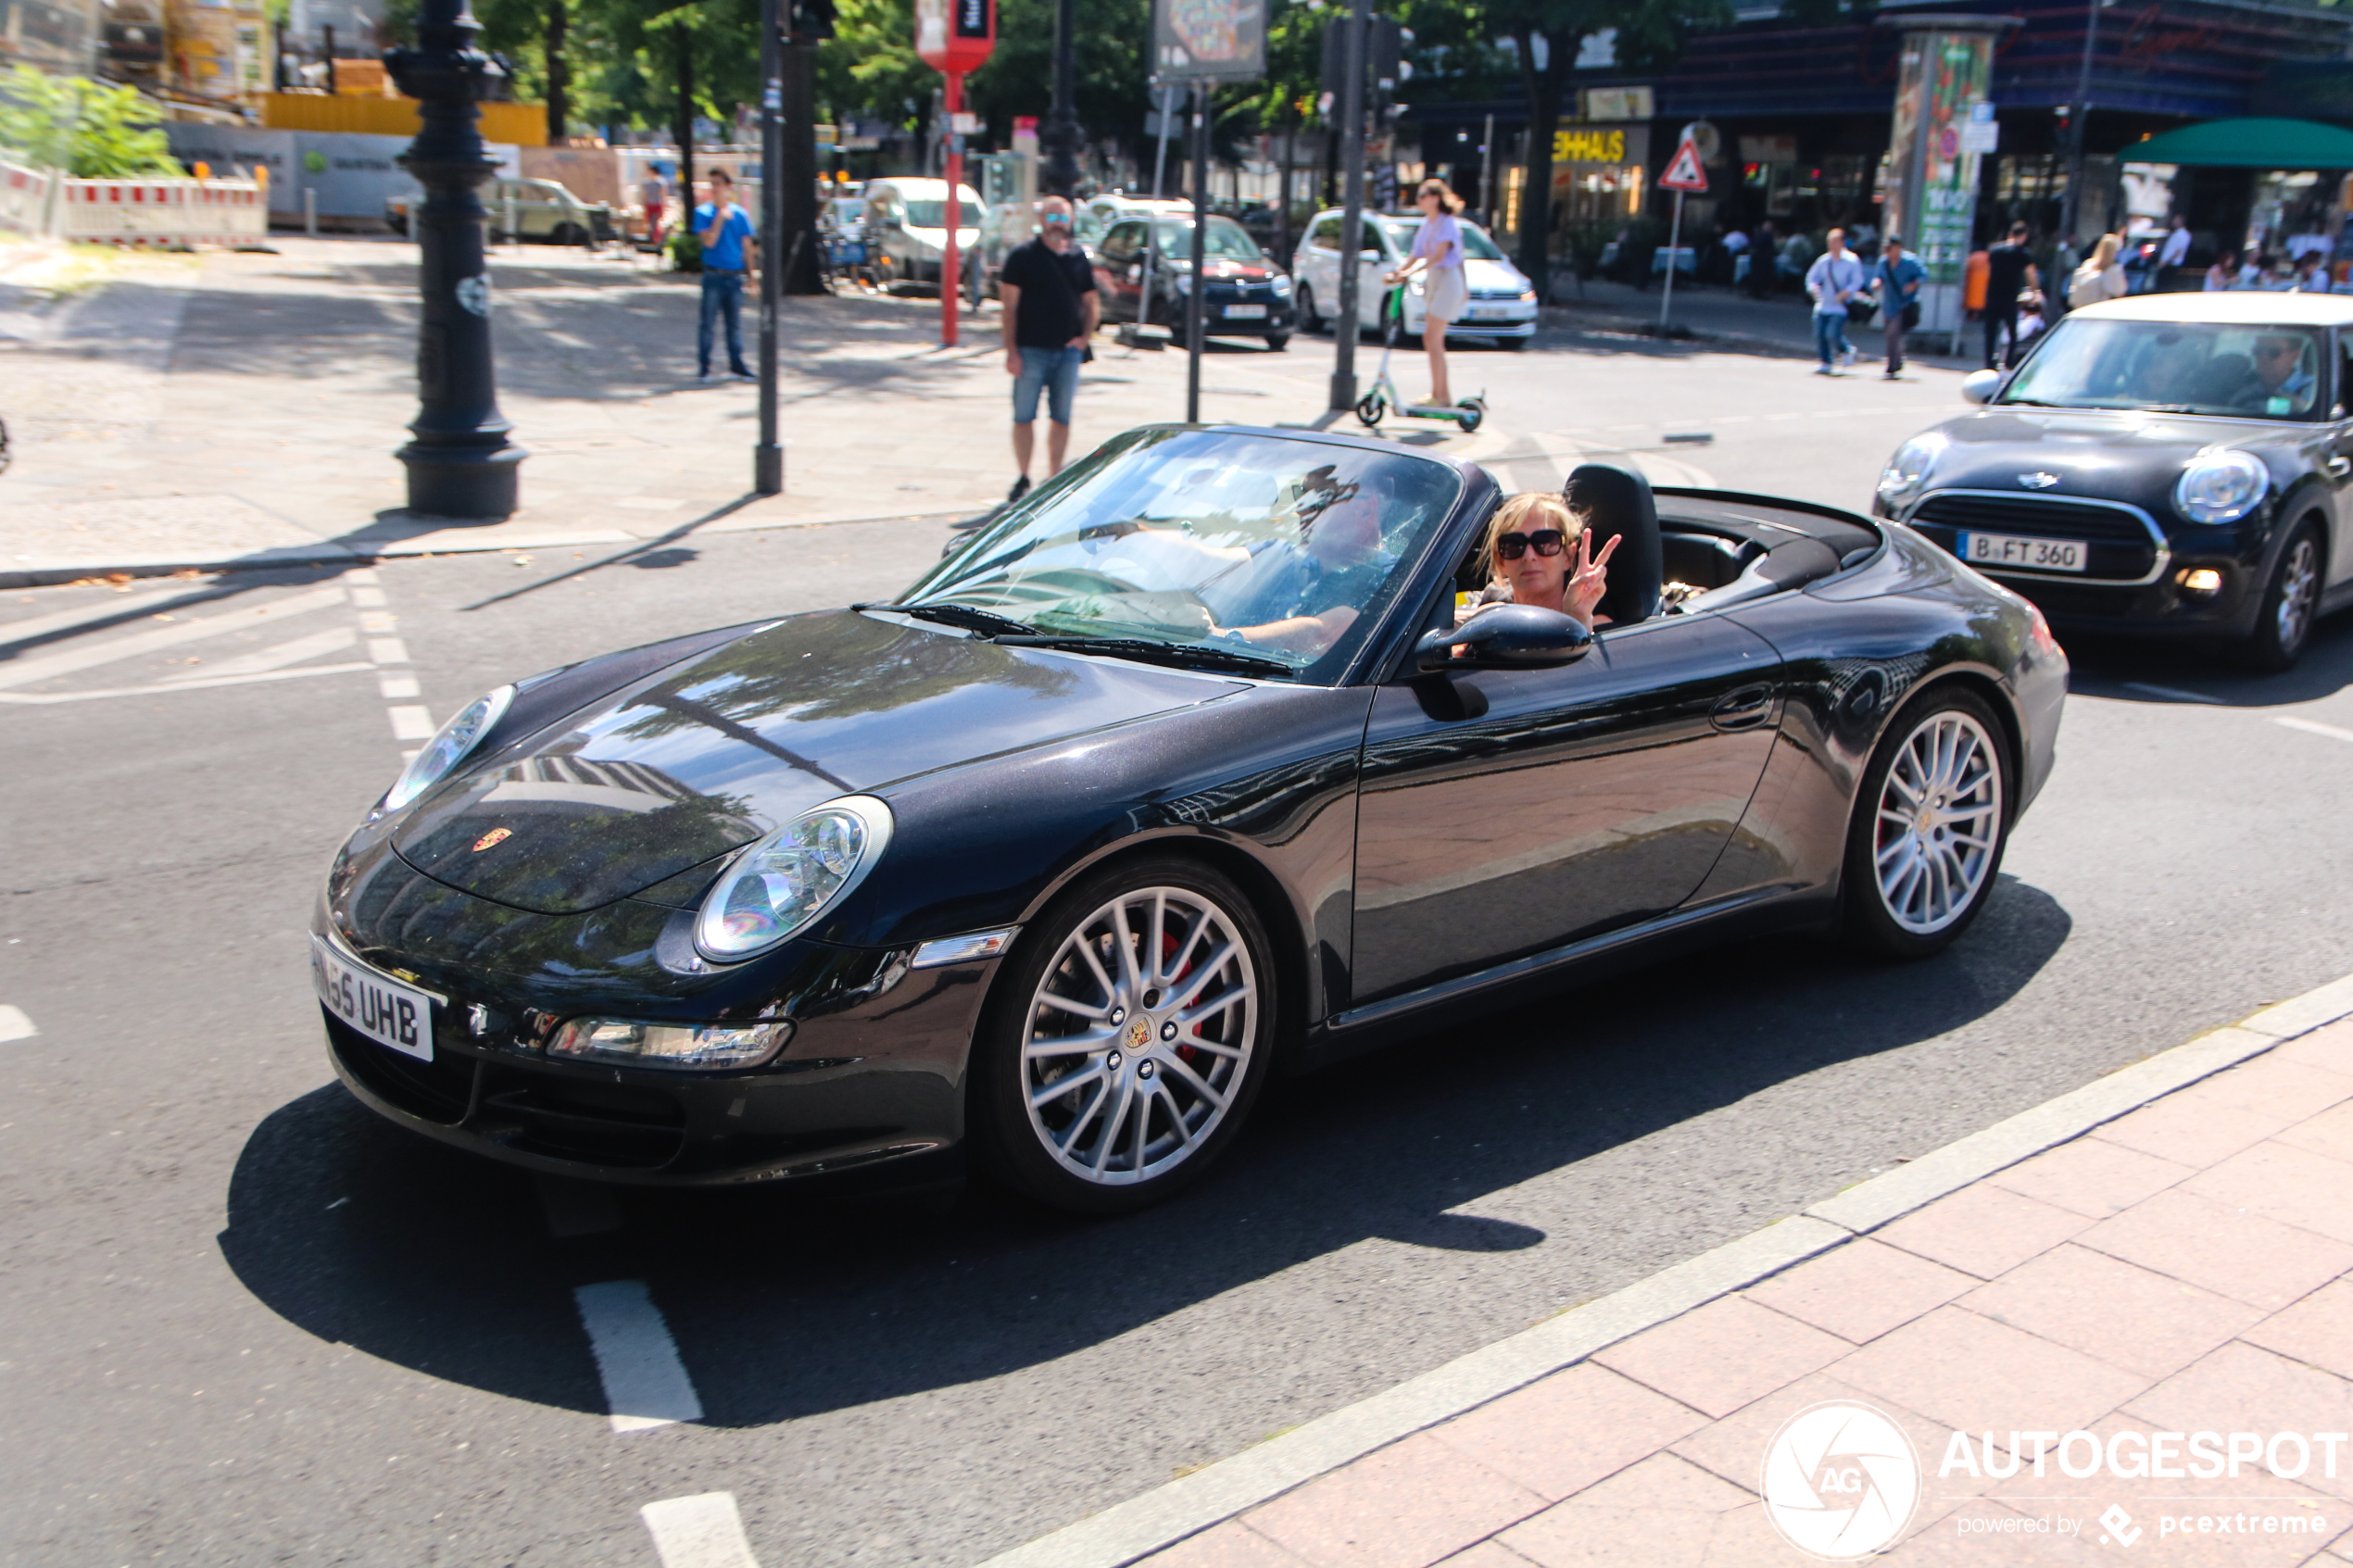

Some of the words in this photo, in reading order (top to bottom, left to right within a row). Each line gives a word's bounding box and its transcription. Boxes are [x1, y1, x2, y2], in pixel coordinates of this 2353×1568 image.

[1976, 537, 1990, 558] B
[2004, 540, 2032, 561] FT
[2035, 545, 2076, 567] 360
[359, 980, 419, 1047] UHB
